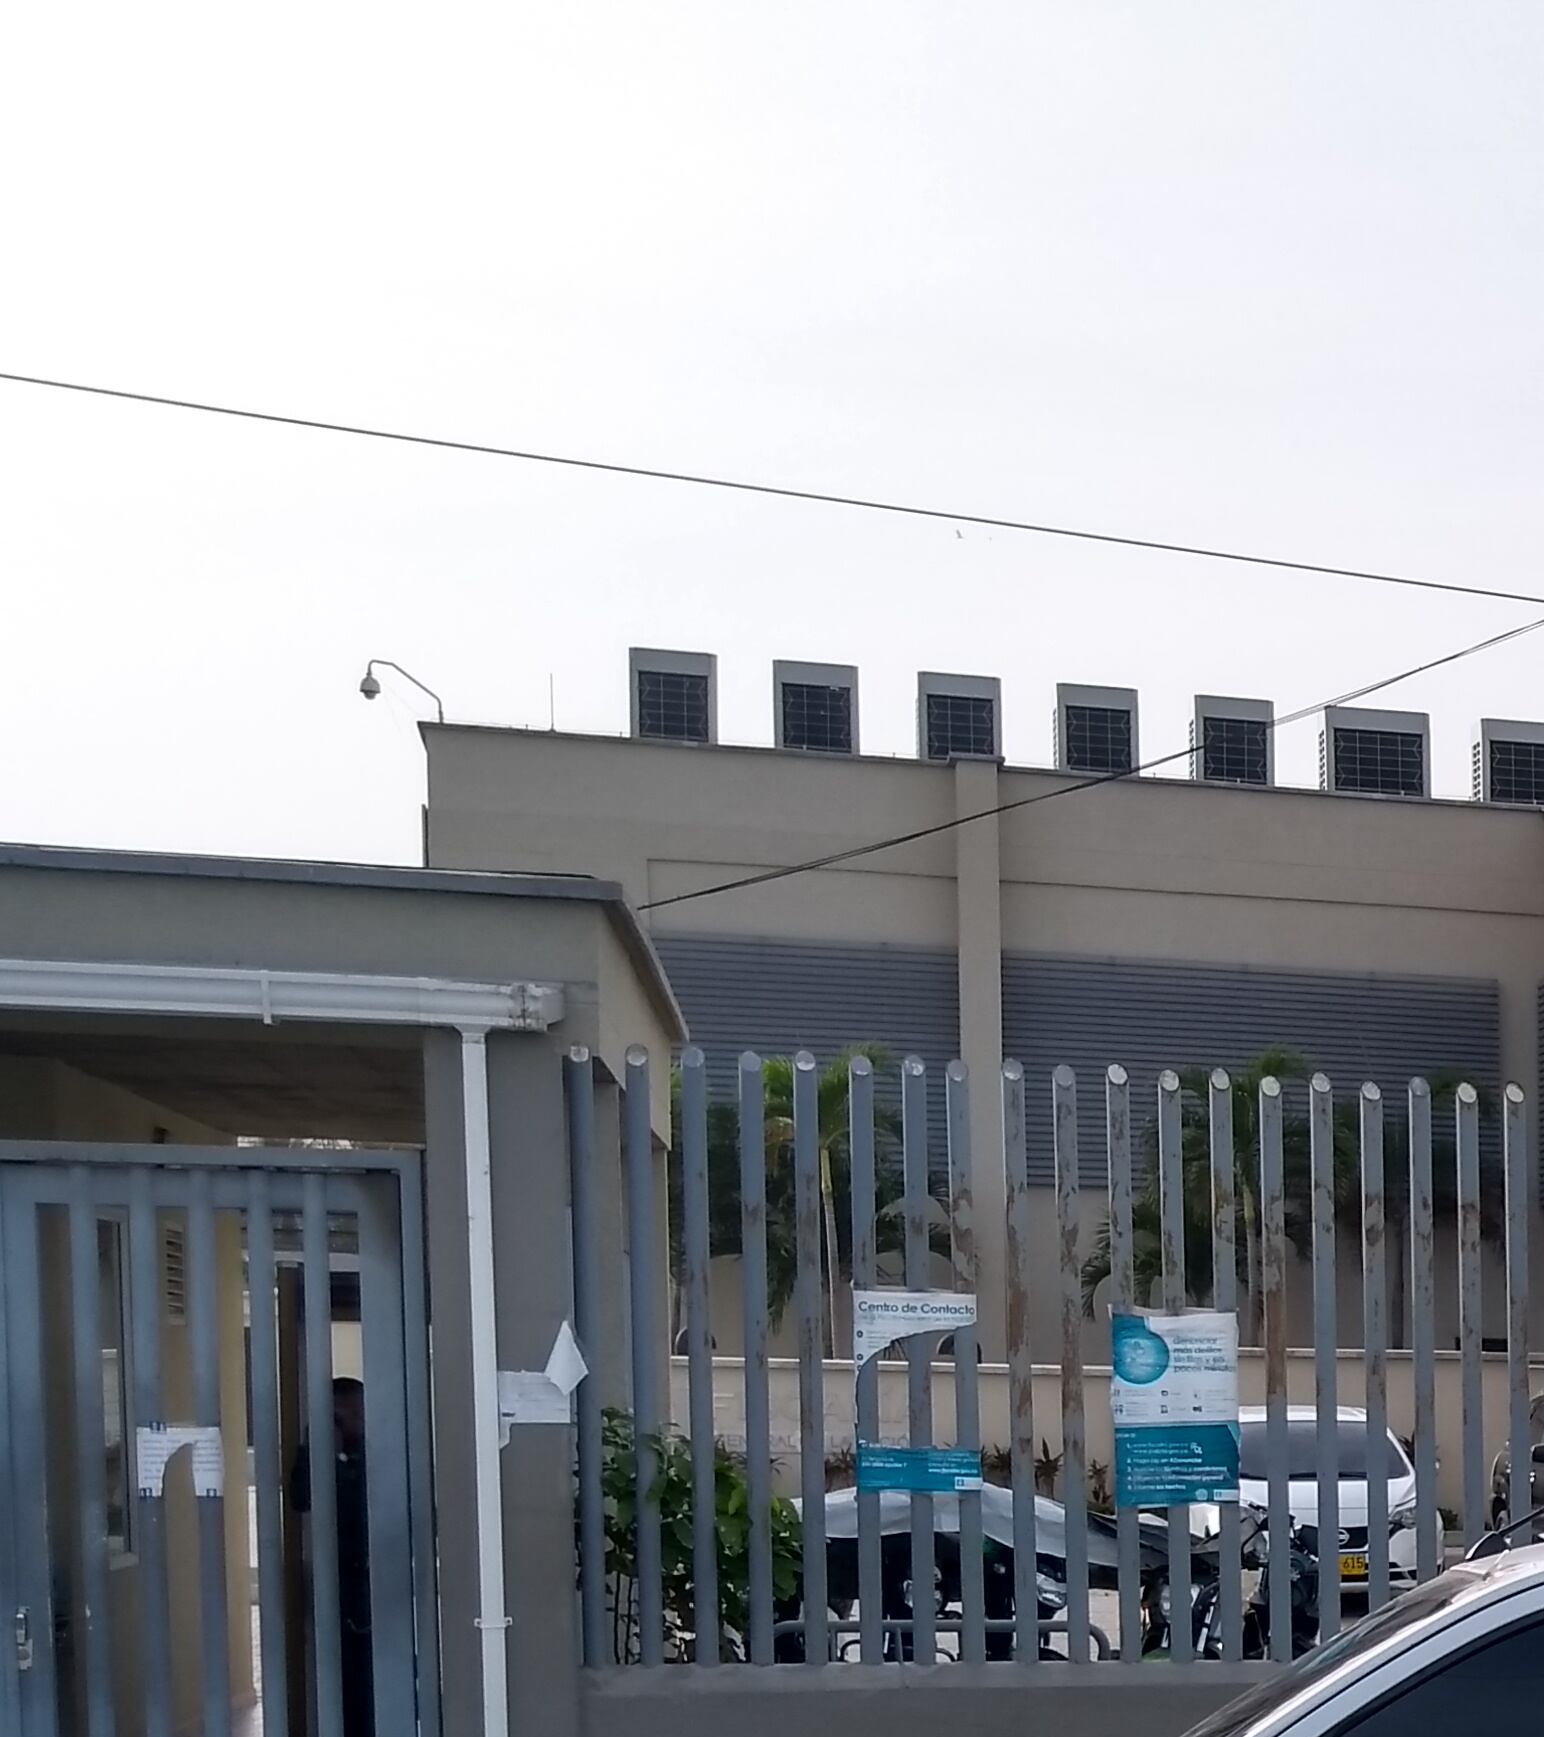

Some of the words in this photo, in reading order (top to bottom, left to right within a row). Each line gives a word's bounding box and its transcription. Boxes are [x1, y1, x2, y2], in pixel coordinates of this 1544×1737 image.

[858, 1301, 899, 1313] Centro
[901, 1303, 918, 1313] de
[920, 1303, 976, 1315] Contacto
[1343, 1555, 1364, 1569] 615
